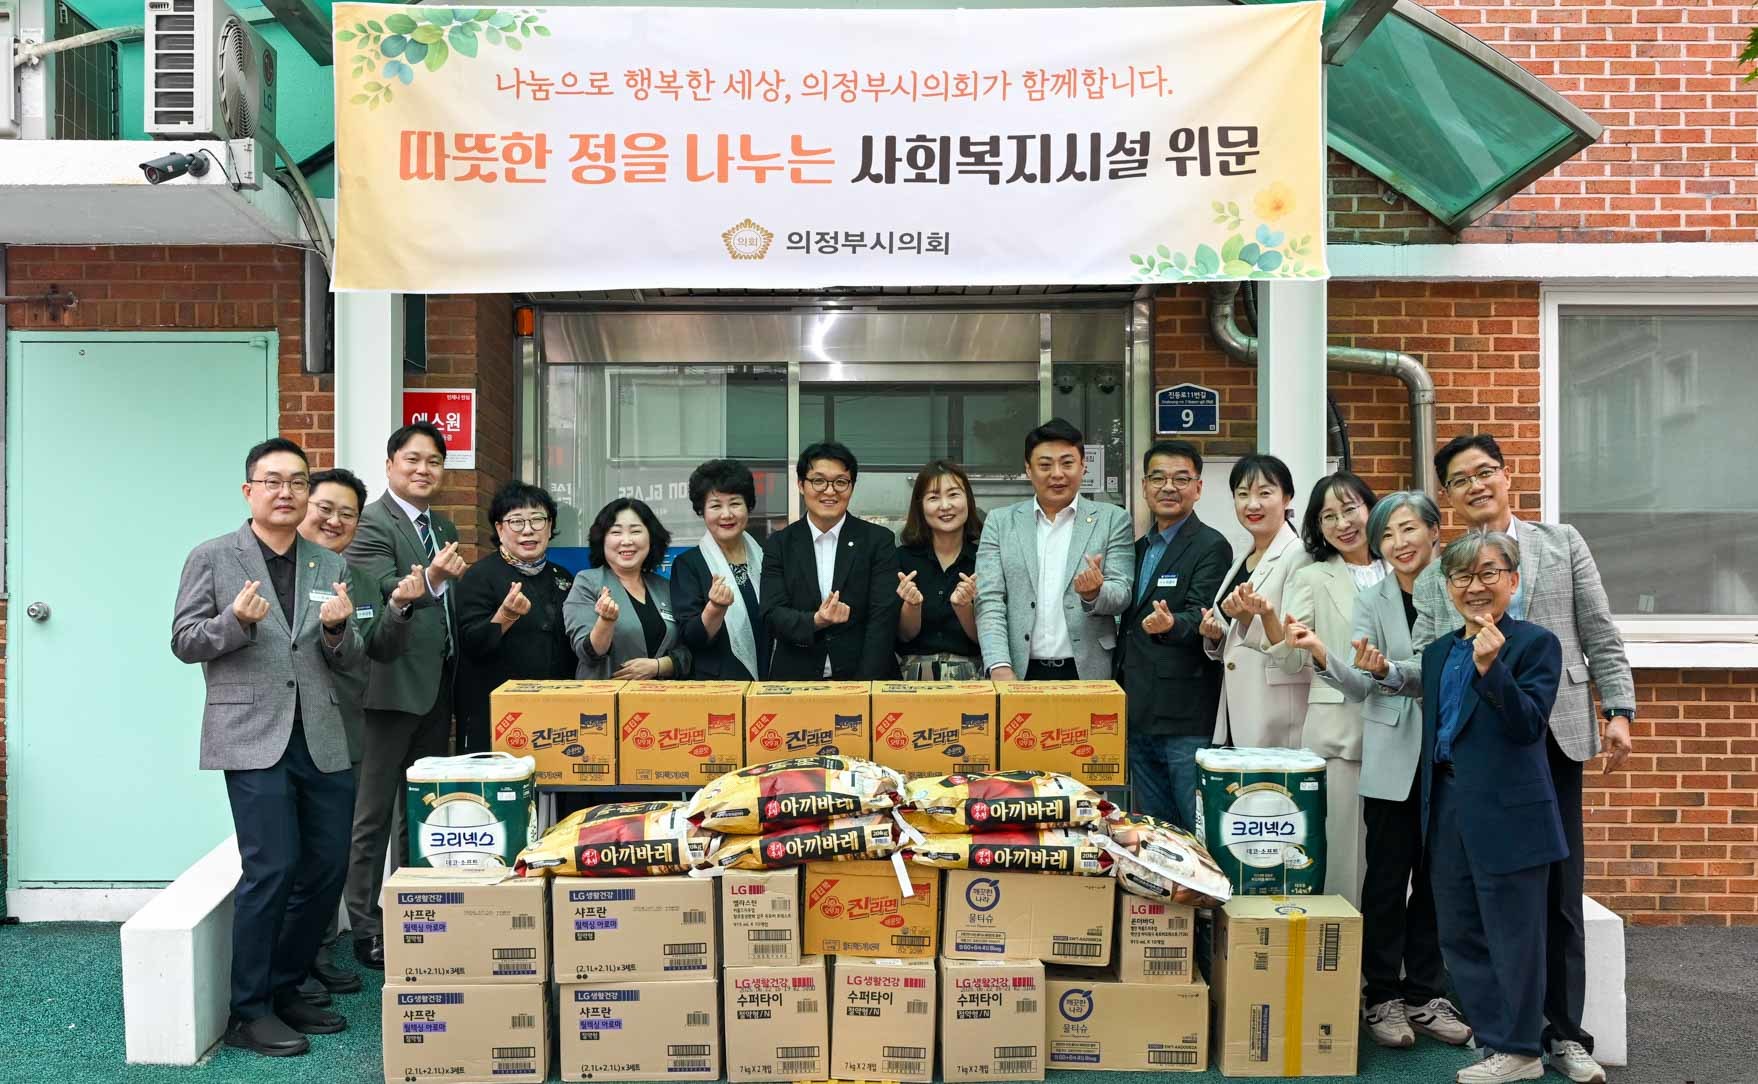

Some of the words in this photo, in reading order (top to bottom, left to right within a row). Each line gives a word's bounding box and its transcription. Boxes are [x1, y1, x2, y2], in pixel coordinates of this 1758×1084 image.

[496, 67, 614, 100] 나눔으로
[624, 69, 715, 102] 행복한
[724, 69, 791, 104] 세상,
[802, 69, 1012, 103] 의정부시의회가
[1022, 65, 1174, 102] 함께합니다.
[263, 90, 273, 112] LG
[400, 131, 552, 184] 따뜻한
[569, 132, 669, 185] 정을
[686, 133, 836, 185] 나누는
[850, 131, 1151, 185] 사회복지시설
[1165, 126, 1260, 177] 위문
[786, 230, 950, 255] 의정부시의회
[1181, 409, 1194, 428] 9
[531, 728, 578, 751] 진라면
[657, 728, 706, 751] 진라면
[785, 729, 833, 752] 진라면
[912, 728, 960, 751] 진라면
[1039, 728, 1088, 751] 진라면
[781, 795, 853, 817] 아끼바레
[990, 799, 1063, 822] 아끼바레
[1231, 821, 1296, 837] 크리넥스
[430, 832, 495, 847] 크리넥스
[786, 831, 858, 855] 아끼바레
[601, 843, 673, 867] 아끼바레
[994, 849, 1067, 869] 아끼바레
[731, 885, 747, 895] LG
[403, 909, 436, 921] 샤프란
[574, 907, 607, 919] 샤프란
[847, 896, 899, 920] 진라면
[1131, 905, 1147, 915] LG
[968, 913, 994, 924] 물티슈
[737, 993, 782, 1007] 수퍼타이
[848, 990, 893, 1005] 수퍼타이
[957, 993, 1002, 1007] 수퍼타이
[403, 1010, 436, 1021] 샤프란
[579, 1007, 612, 1018] 샤프란
[1069, 1006, 1083, 1014] 나라
[1063, 1024, 1088, 1034] 물티슈
